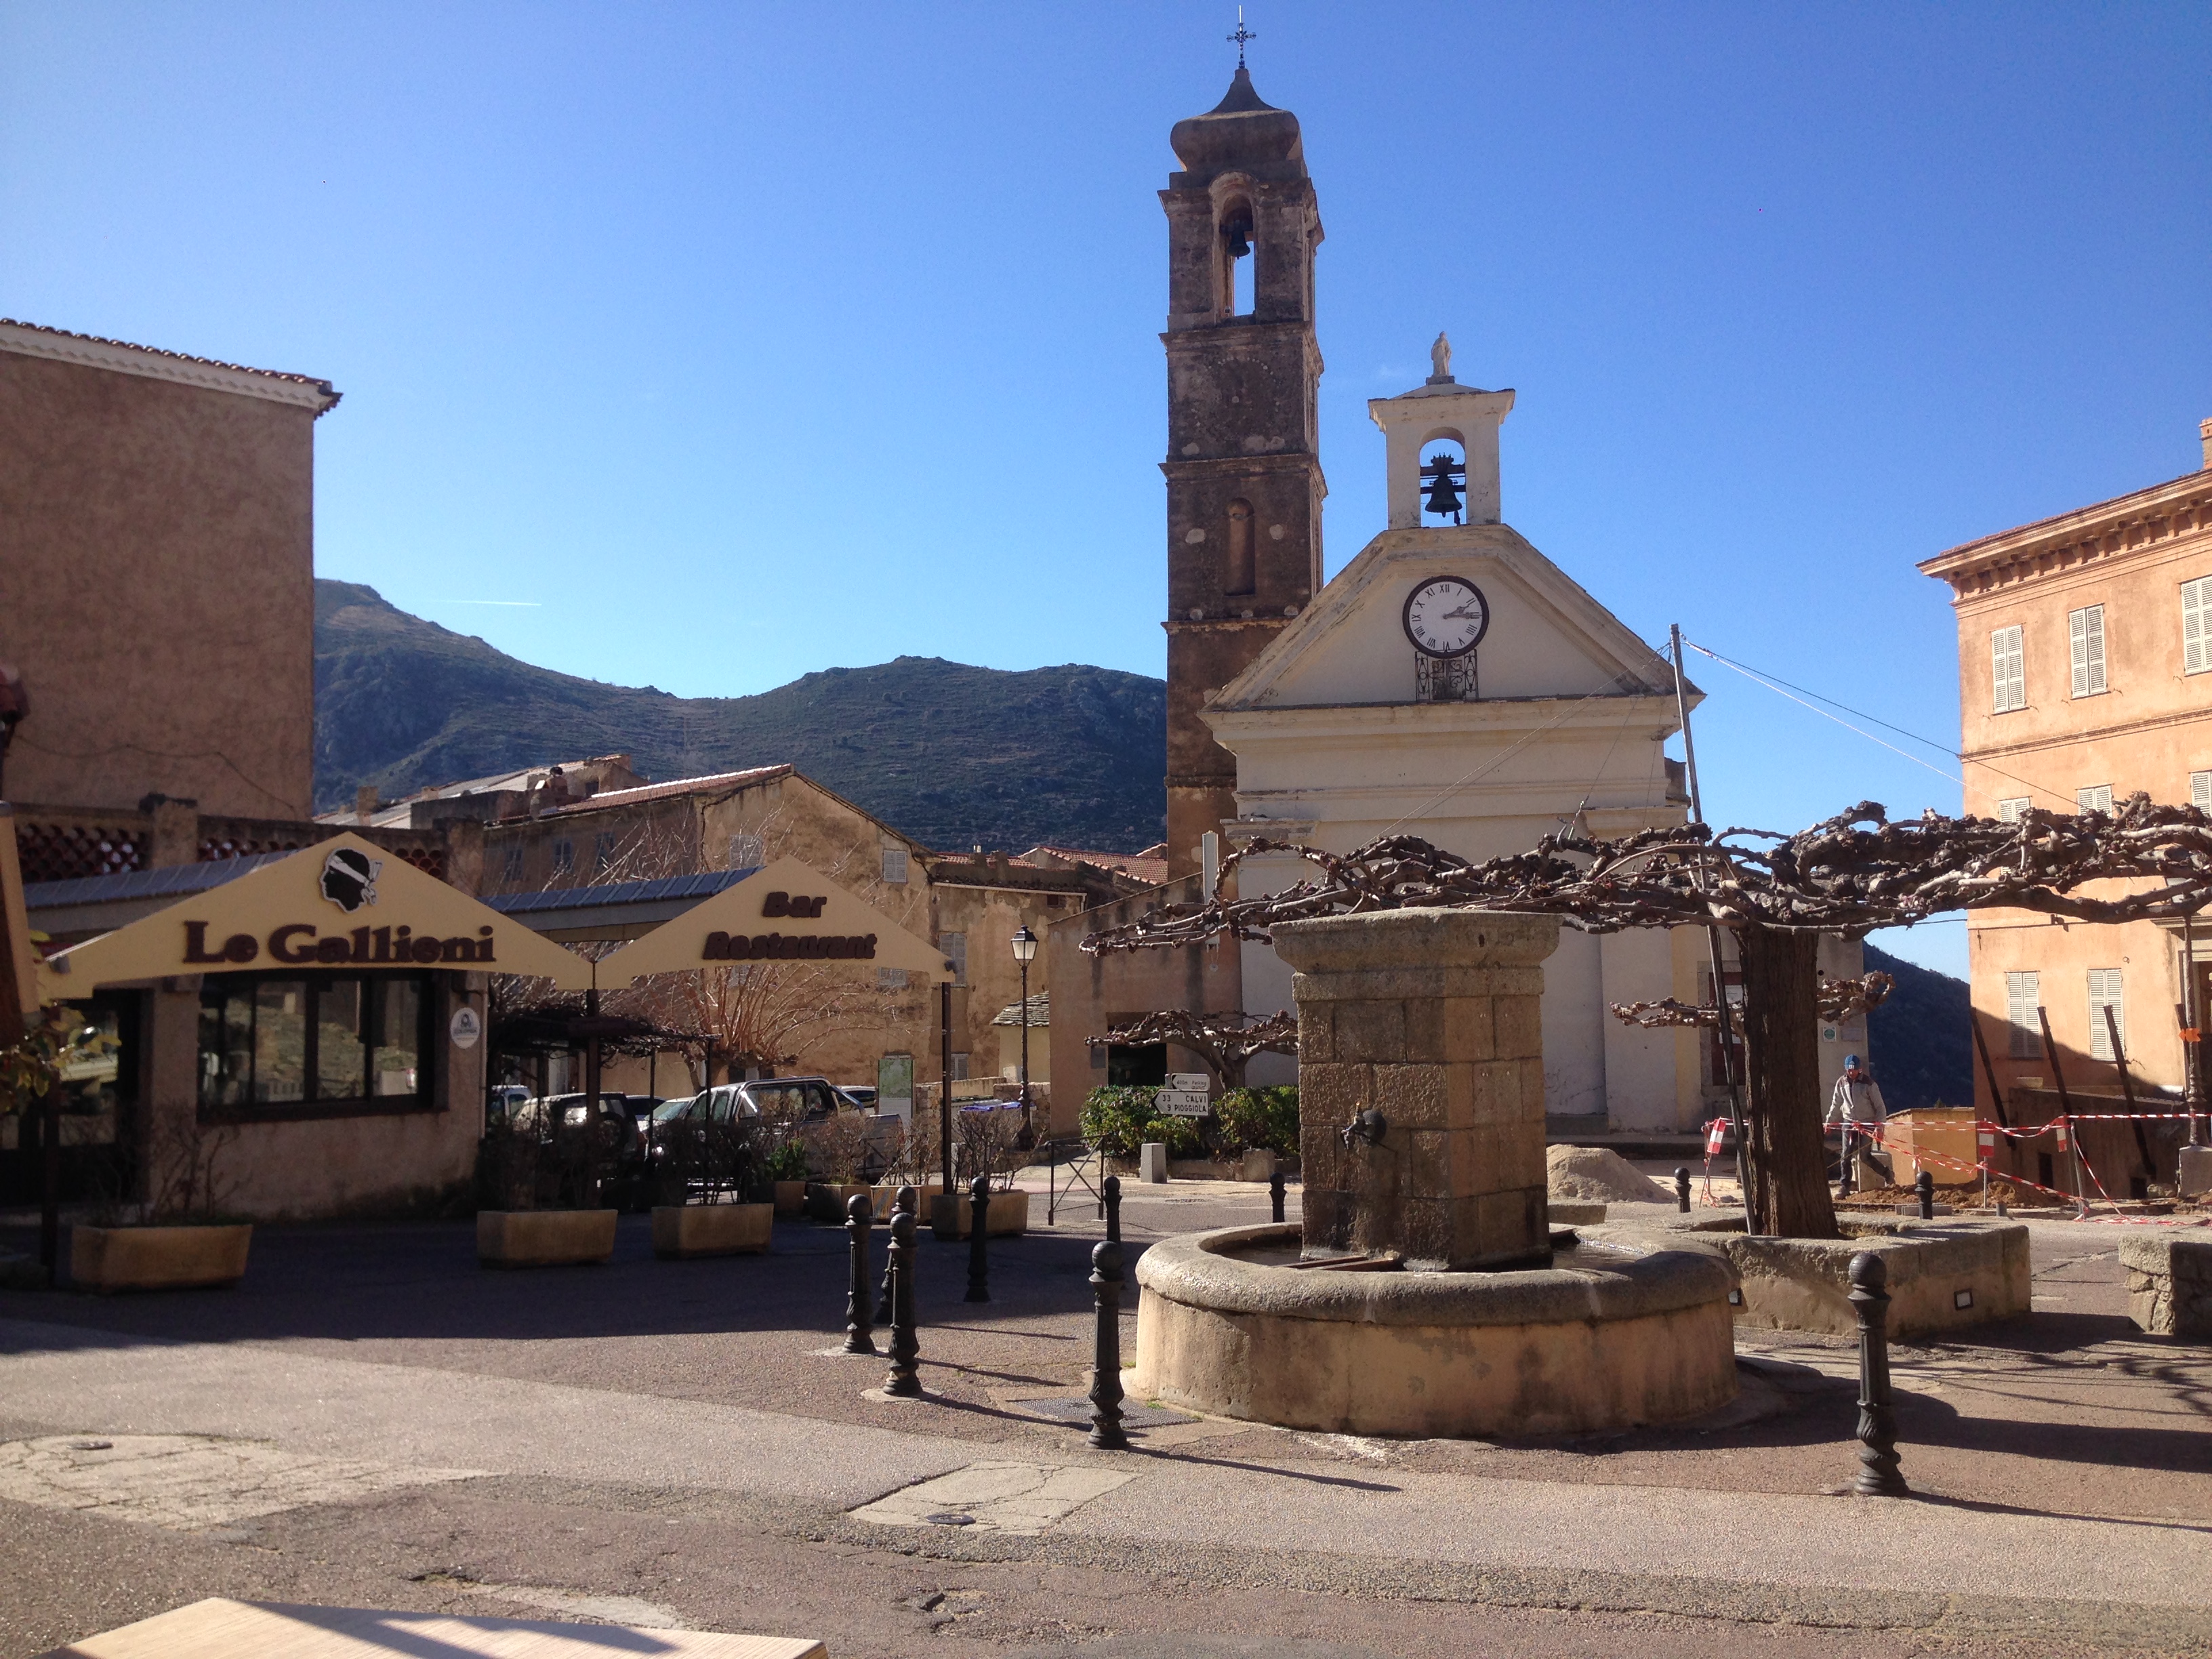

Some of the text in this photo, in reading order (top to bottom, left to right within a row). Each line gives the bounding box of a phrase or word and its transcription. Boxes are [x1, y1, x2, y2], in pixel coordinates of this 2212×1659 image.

[1425, 588, 1435, 598] XI
[1439, 583, 1450, 594] XII
[1456, 588, 1462, 596] I
[1414, 600, 1425, 609] X
[1466, 597, 1476, 605] II
[1412, 614, 1421, 622] IX
[1458, 637, 1465, 646] V
[762, 891, 827, 918] Bar
[182, 920, 497, 964] Le Gallieni
[702, 931, 878, 960] Restaurant
[1185, 1094, 1206, 1103] CALVI
[1174, 1104, 1206, 1112] PIOGGIOLA
